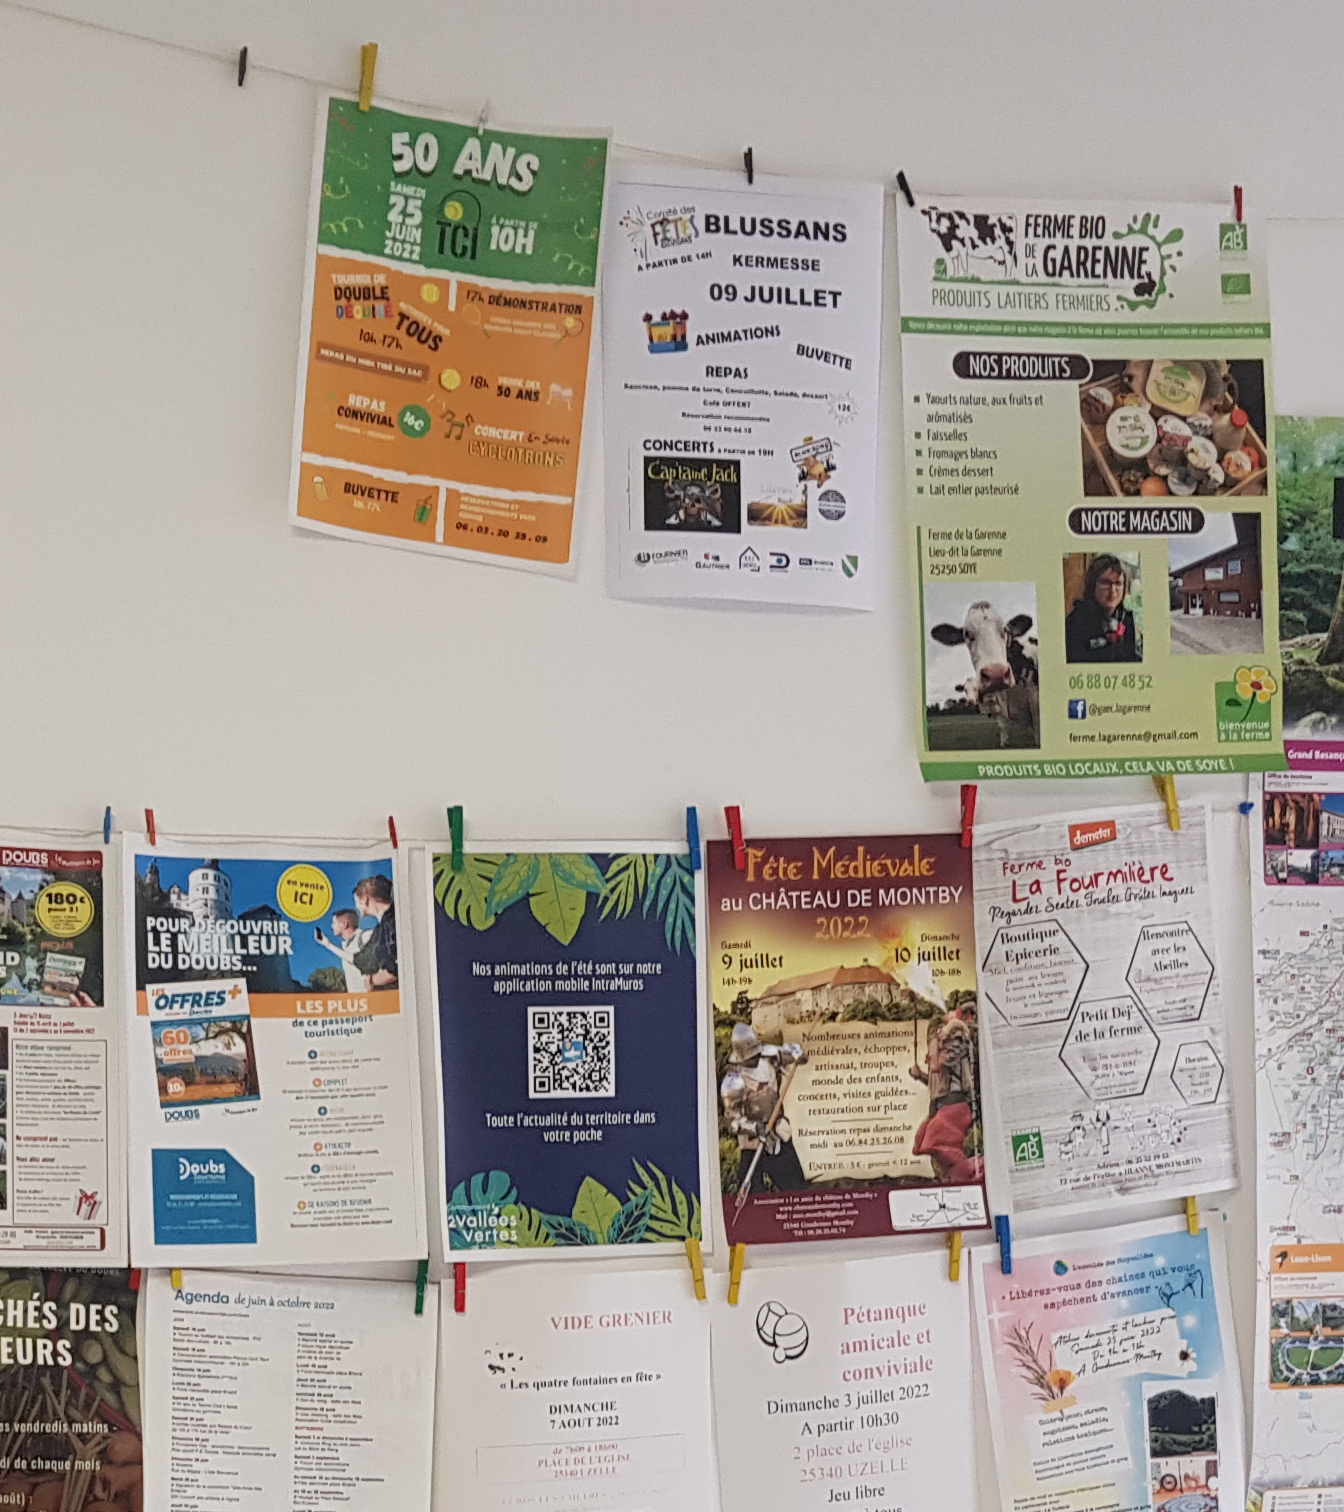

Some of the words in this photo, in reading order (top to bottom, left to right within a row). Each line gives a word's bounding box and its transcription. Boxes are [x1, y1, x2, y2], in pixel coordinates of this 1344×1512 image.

[390, 132, 438, 174] 50
[454, 138, 540, 194] ANS
[387, 195, 423, 224] 25
[386, 224, 422, 242] JUIN
[704, 214, 847, 243] BLUSSANS
[1024, 216, 1072, 240] FERME
[1079, 216, 1106, 239] BIO
[384, 239, 420, 260] 2022
[489, 226, 534, 254] 10H
[732, 254, 820, 272] KERMESSE
[1025, 244, 1037, 260] DE
[1043, 244, 1149, 280] GARENNE
[1025, 262, 1039, 278] LA
[334, 286, 390, 301] DOUBLE
[709, 284, 738, 302] 09
[744, 285, 842, 309] JUILLET
[931, 289, 991, 308] PRODUITS
[997, 292, 1049, 310] LAITIERS
[1055, 293, 1111, 312] FERMIERS
[394, 312, 443, 352] TOUS
[695, 325, 781, 347] ANIMATIONS
[796, 343, 852, 370] BUVETTE
[968, 356, 995, 376] NOS
[1000, 355, 1071, 378] PRODUITS
[705, 364, 748, 380] REPAS
[336, 406, 394, 428] CONVIVIAL
[643, 438, 715, 454] CONCERTS
[927, 447, 967, 461] Fromages
[970, 448, 998, 460] blancs
[343, 480, 399, 504] BUVETTE
[1081, 510, 1124, 531] NOTRE
[1129, 512, 1192, 532] MAGASIN
[1288, 749, 1311, 760] Grand
[746, 847, 802, 882] Fête
[813, 844, 935, 880] Médiévale
[1011, 879, 1043, 903] La
[1056, 865, 1174, 896] Fourmilière
[293, 889, 314, 906] ICI
[721, 893, 742, 911] au
[749, 887, 843, 909] CHÂTEAU
[848, 888, 872, 906] DE
[879, 886, 962, 905] MONTBY
[146, 916, 189, 933] POUR
[192, 916, 290, 936] DÉCOUVRIR
[815, 916, 871, 941] 2022
[147, 935, 173, 953] LE
[177, 935, 293, 956] MEILLEUR
[894, 948, 911, 963] 10
[916, 946, 961, 966] juillet
[147, 954, 173, 969] DU
[177, 953, 257, 972] DOUBS...
[721, 955, 734, 971] 9
[739, 953, 784, 974] juillet
[494, 978, 552, 993] application
[555, 977, 588, 993] mobile
[592, 977, 644, 991] IntraMuros
[296, 999, 325, 1014] LES
[329, 999, 369, 1014] PLUS
[174, 1288, 229, 1305] Agenda
[234, 1293, 246, 1305] de
[249, 1292, 267, 1309] juin
[277, 1295, 310, 1309] octobre
[313, 1299, 334, 1310] 2022
[69, 1304, 119, 1332] DES
[550, 1315, 593, 1332] VIDE
[599, 1309, 673, 1330] GRENIER
[842, 1301, 927, 1328] Pétanque
[840, 1331, 910, 1357] amicale
[913, 1329, 932, 1348] et
[842, 1356, 934, 1383] conviviale
[766, 1394, 840, 1415] Dimanche
[844, 1392, 852, 1408] 3
[856, 1388, 895, 1410] juillet
[897, 1382, 930, 1402] 2022
